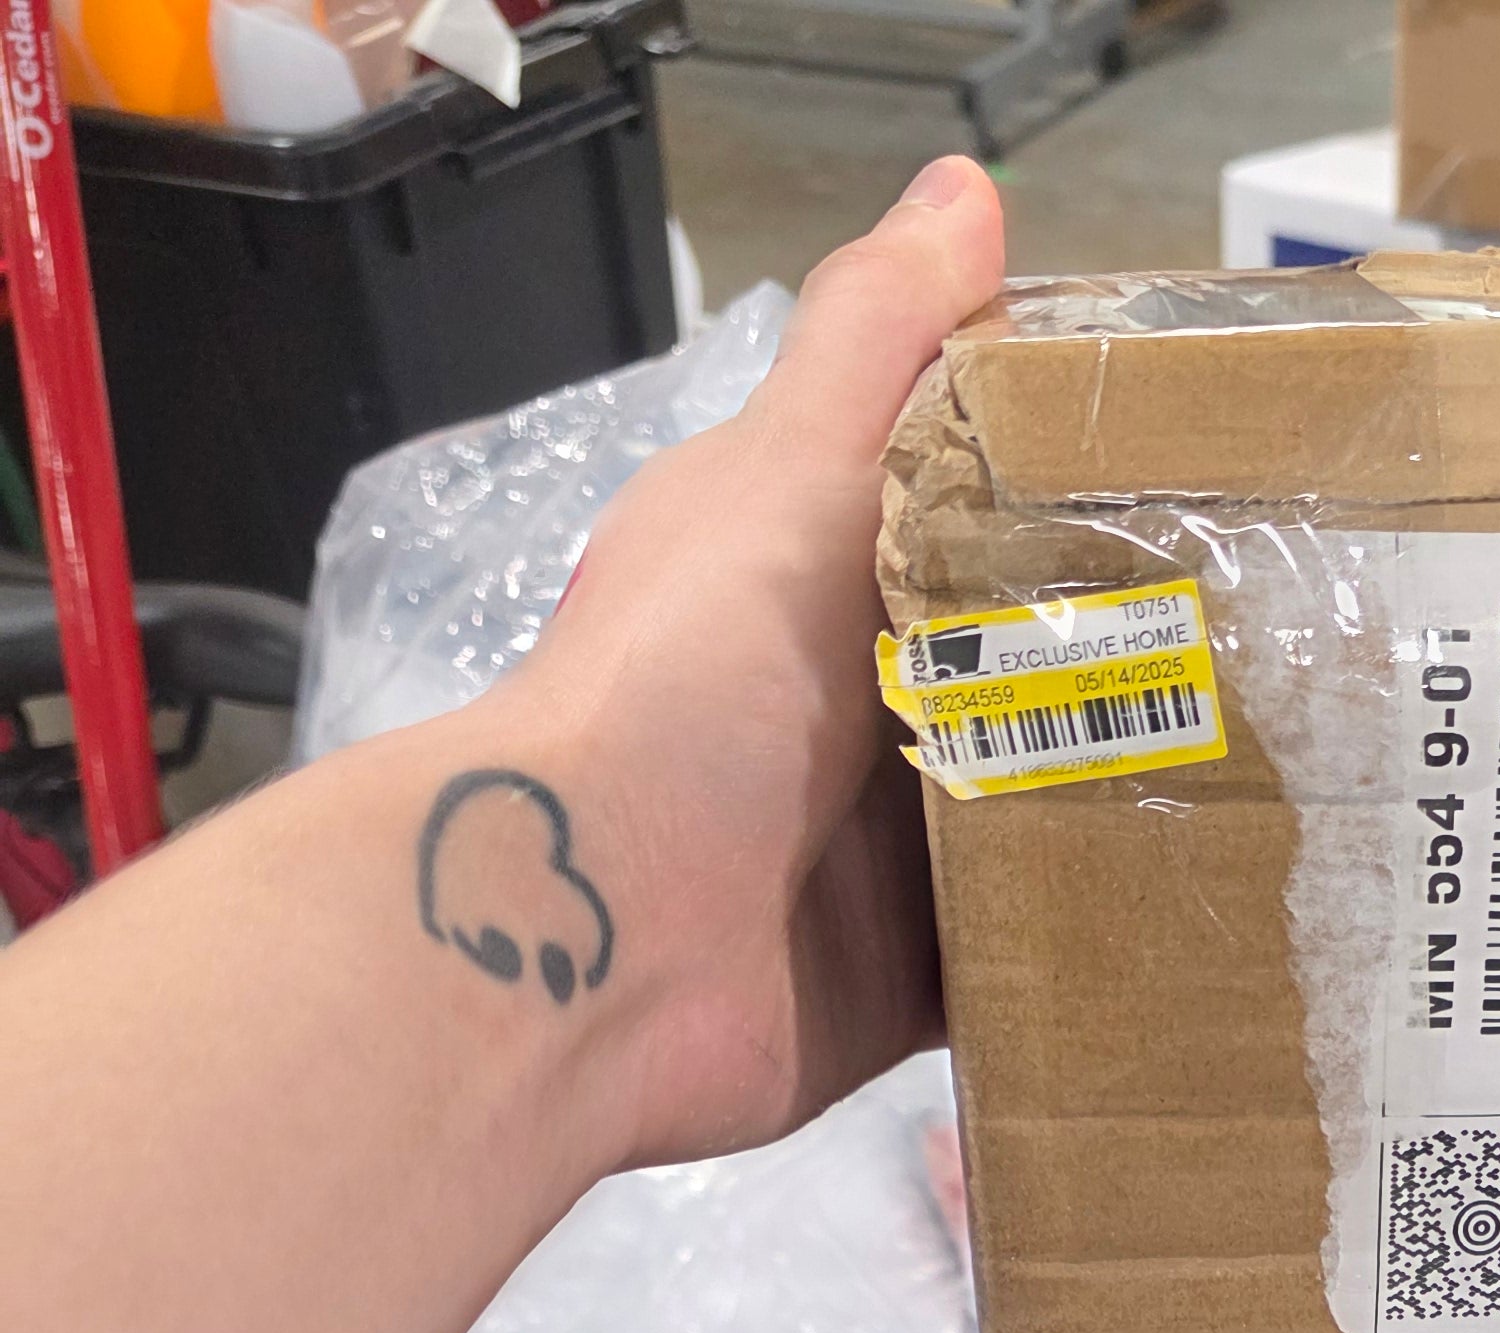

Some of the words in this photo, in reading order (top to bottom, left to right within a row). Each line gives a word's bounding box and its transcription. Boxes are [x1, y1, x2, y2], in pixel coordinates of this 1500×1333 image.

[1119, 595, 1178, 621] T0751
[999, 635, 1119, 672] EXCLUSIVE
[1124, 623, 1189, 652] HOME
[1075, 656, 1185, 692] 05/14/2025
[1417, 793, 1464, 904] 554
[1408, 934, 1458, 1029] MN
